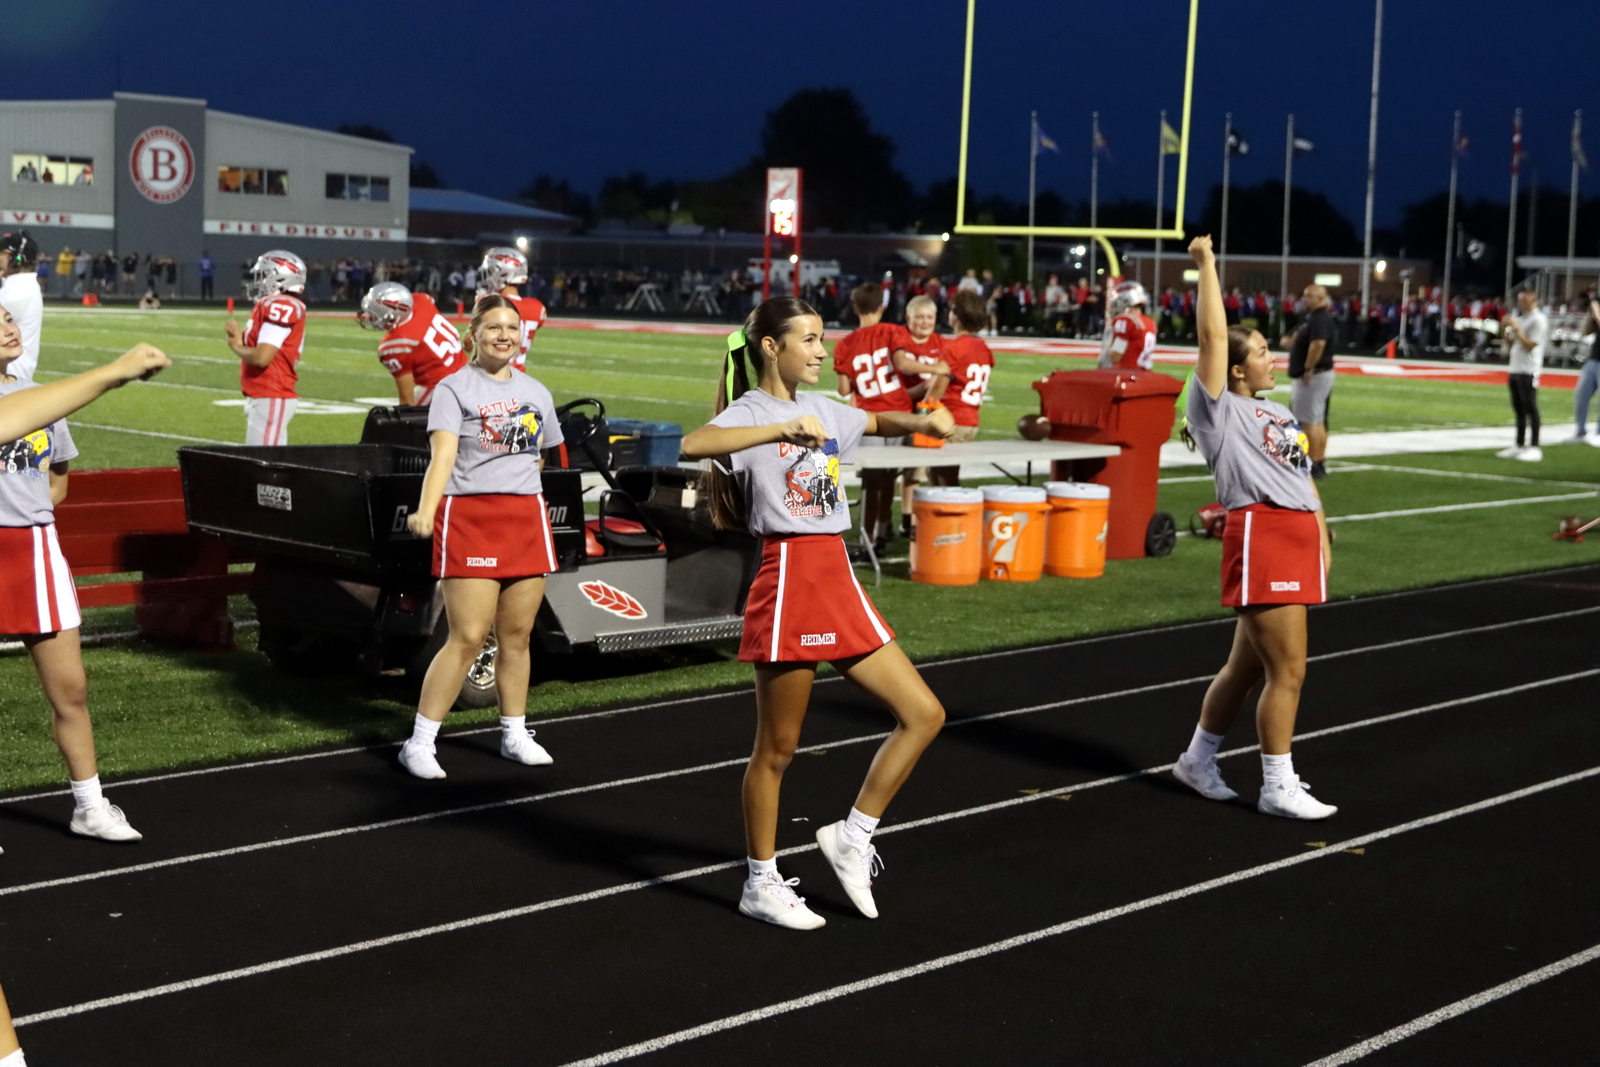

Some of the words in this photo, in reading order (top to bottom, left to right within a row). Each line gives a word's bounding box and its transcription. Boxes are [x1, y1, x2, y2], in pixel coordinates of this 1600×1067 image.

[148, 147, 178, 182] B
[0, 212, 71, 224] VUE
[219, 223, 390, 238] FIELDHOUSE
[268, 303, 293, 323] 57
[423, 314, 462, 367] 50
[852, 347, 901, 398] 22
[477, 398, 521, 418] BATTLE
[992, 515, 1013, 540] G
[466, 557, 498, 567] REDMEN
[800, 632, 836, 646] REDMEN
